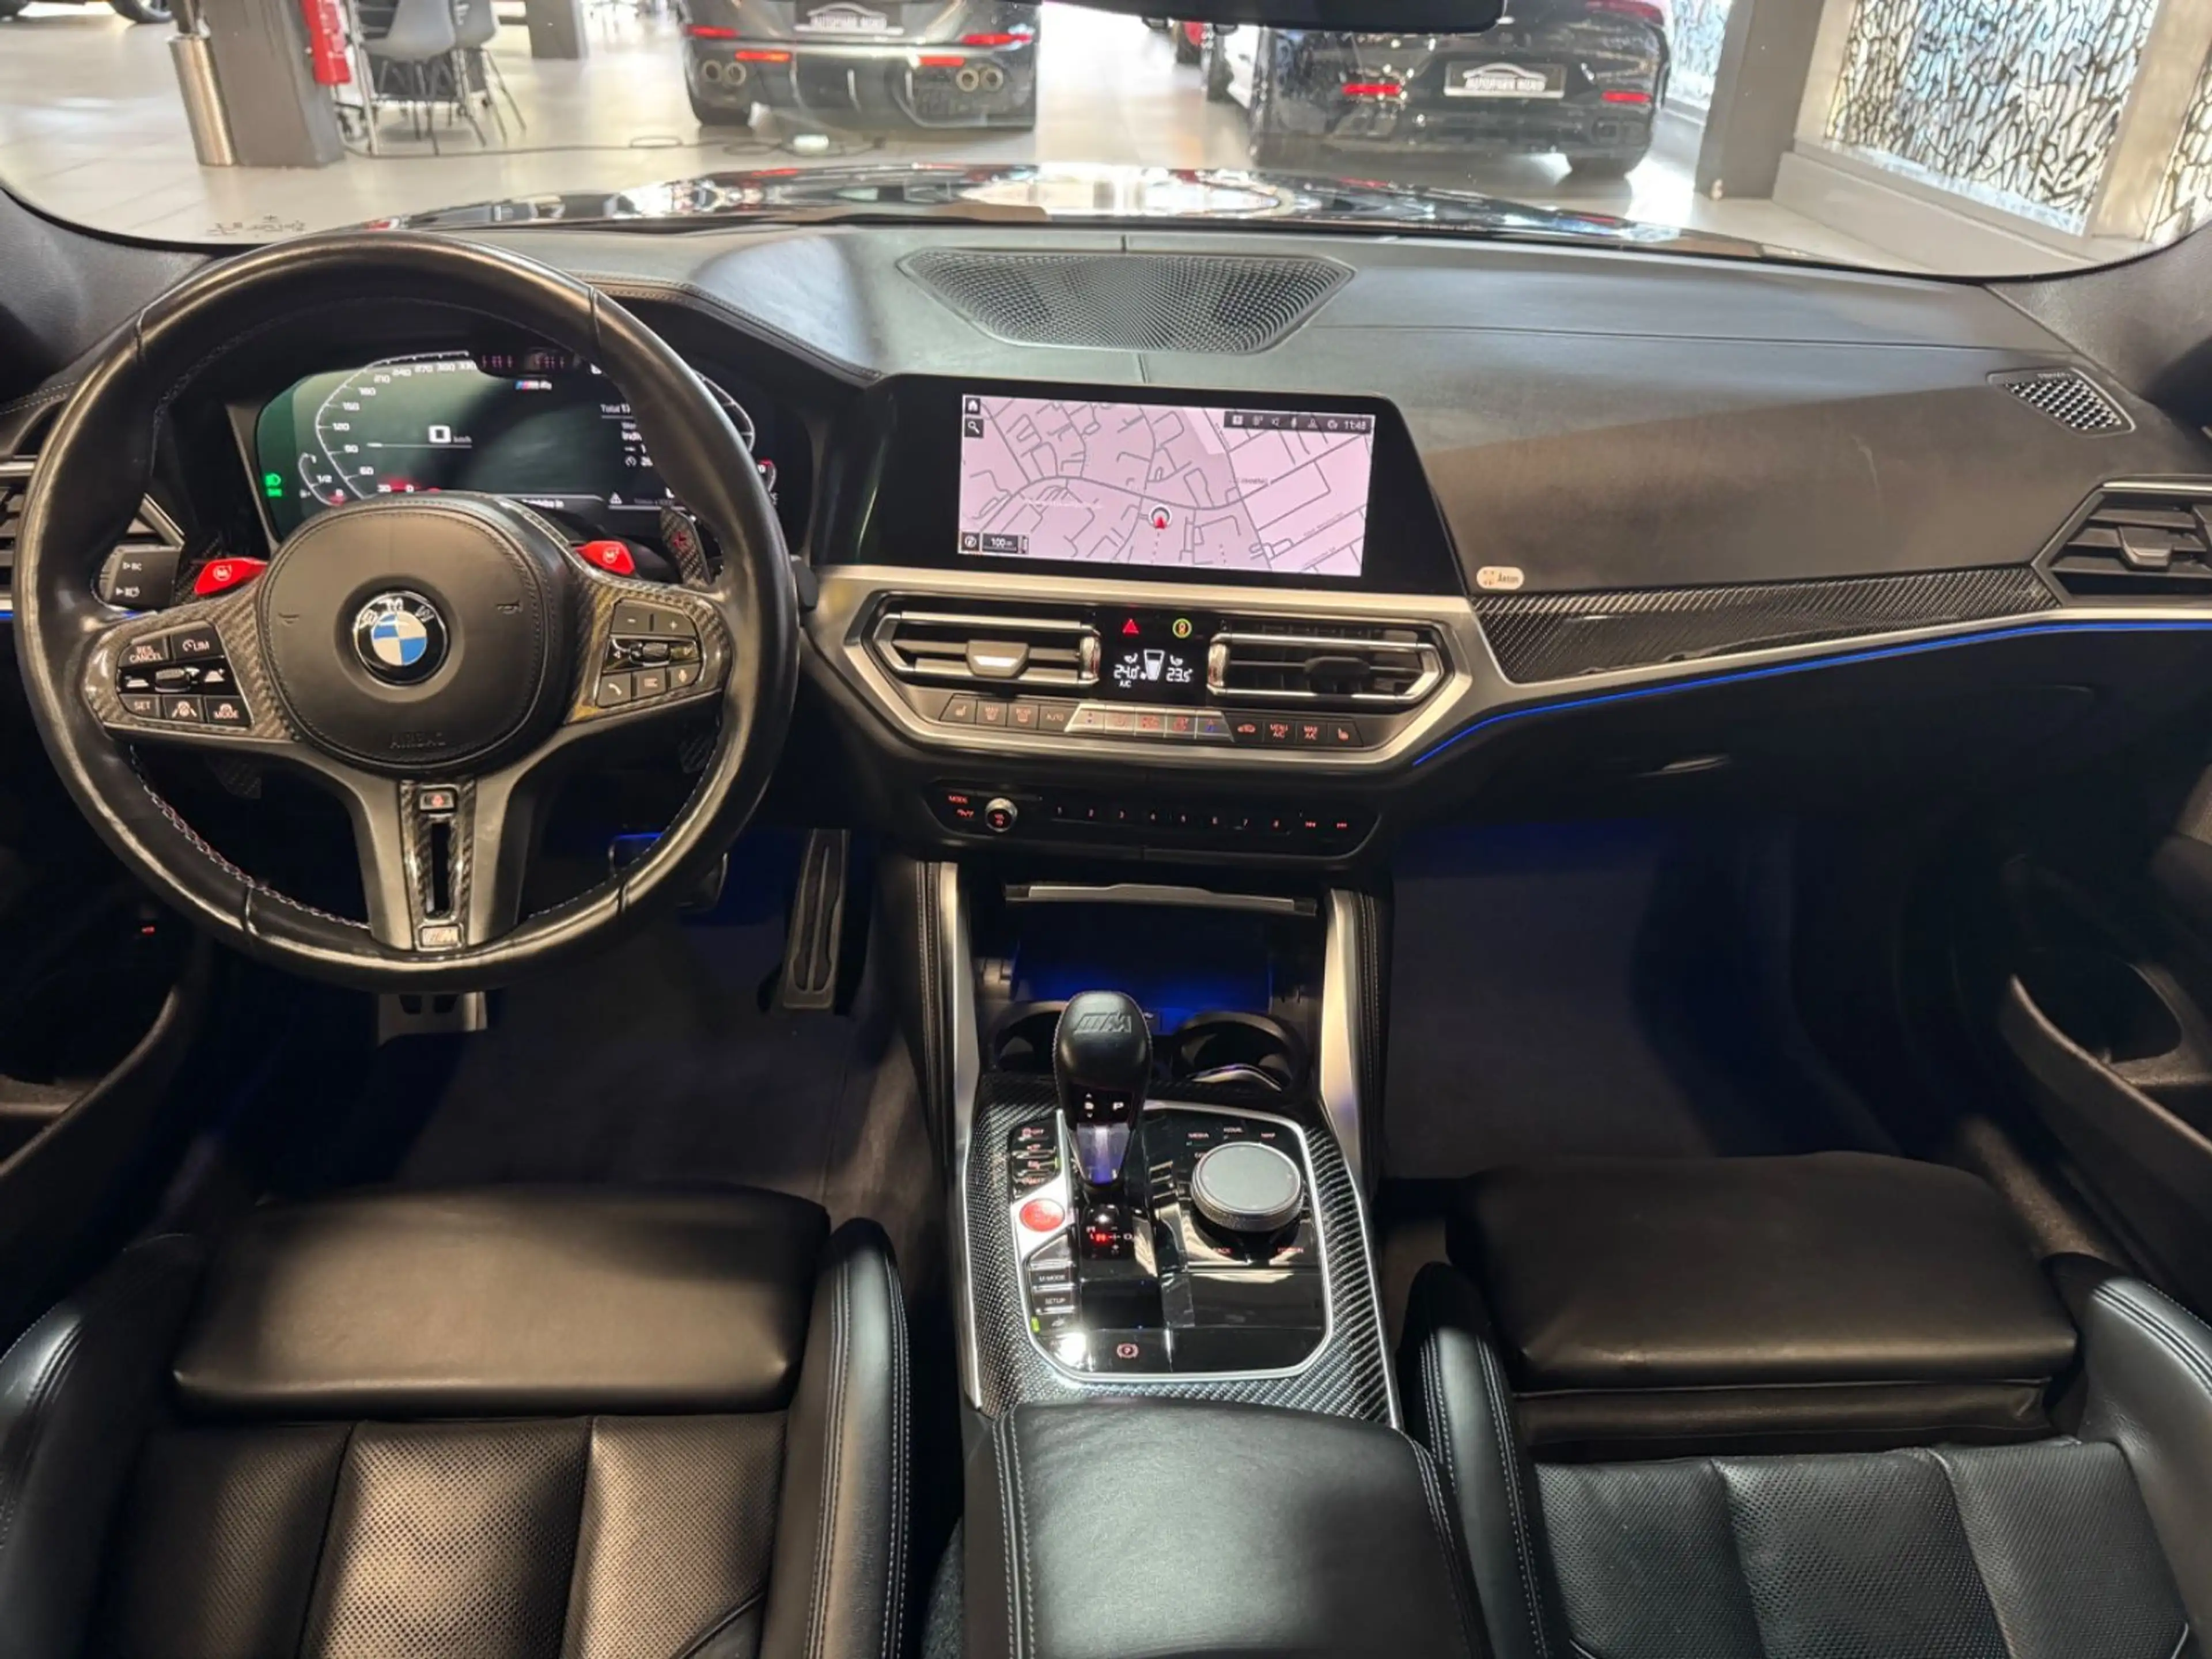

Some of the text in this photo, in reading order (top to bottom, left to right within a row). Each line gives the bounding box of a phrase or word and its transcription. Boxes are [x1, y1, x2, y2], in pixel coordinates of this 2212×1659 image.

[428, 425, 451, 443] 0
[991, 537, 1006, 547] 100
[129, 652, 163, 663] CANCEL
[134, 700, 150, 711] SET
